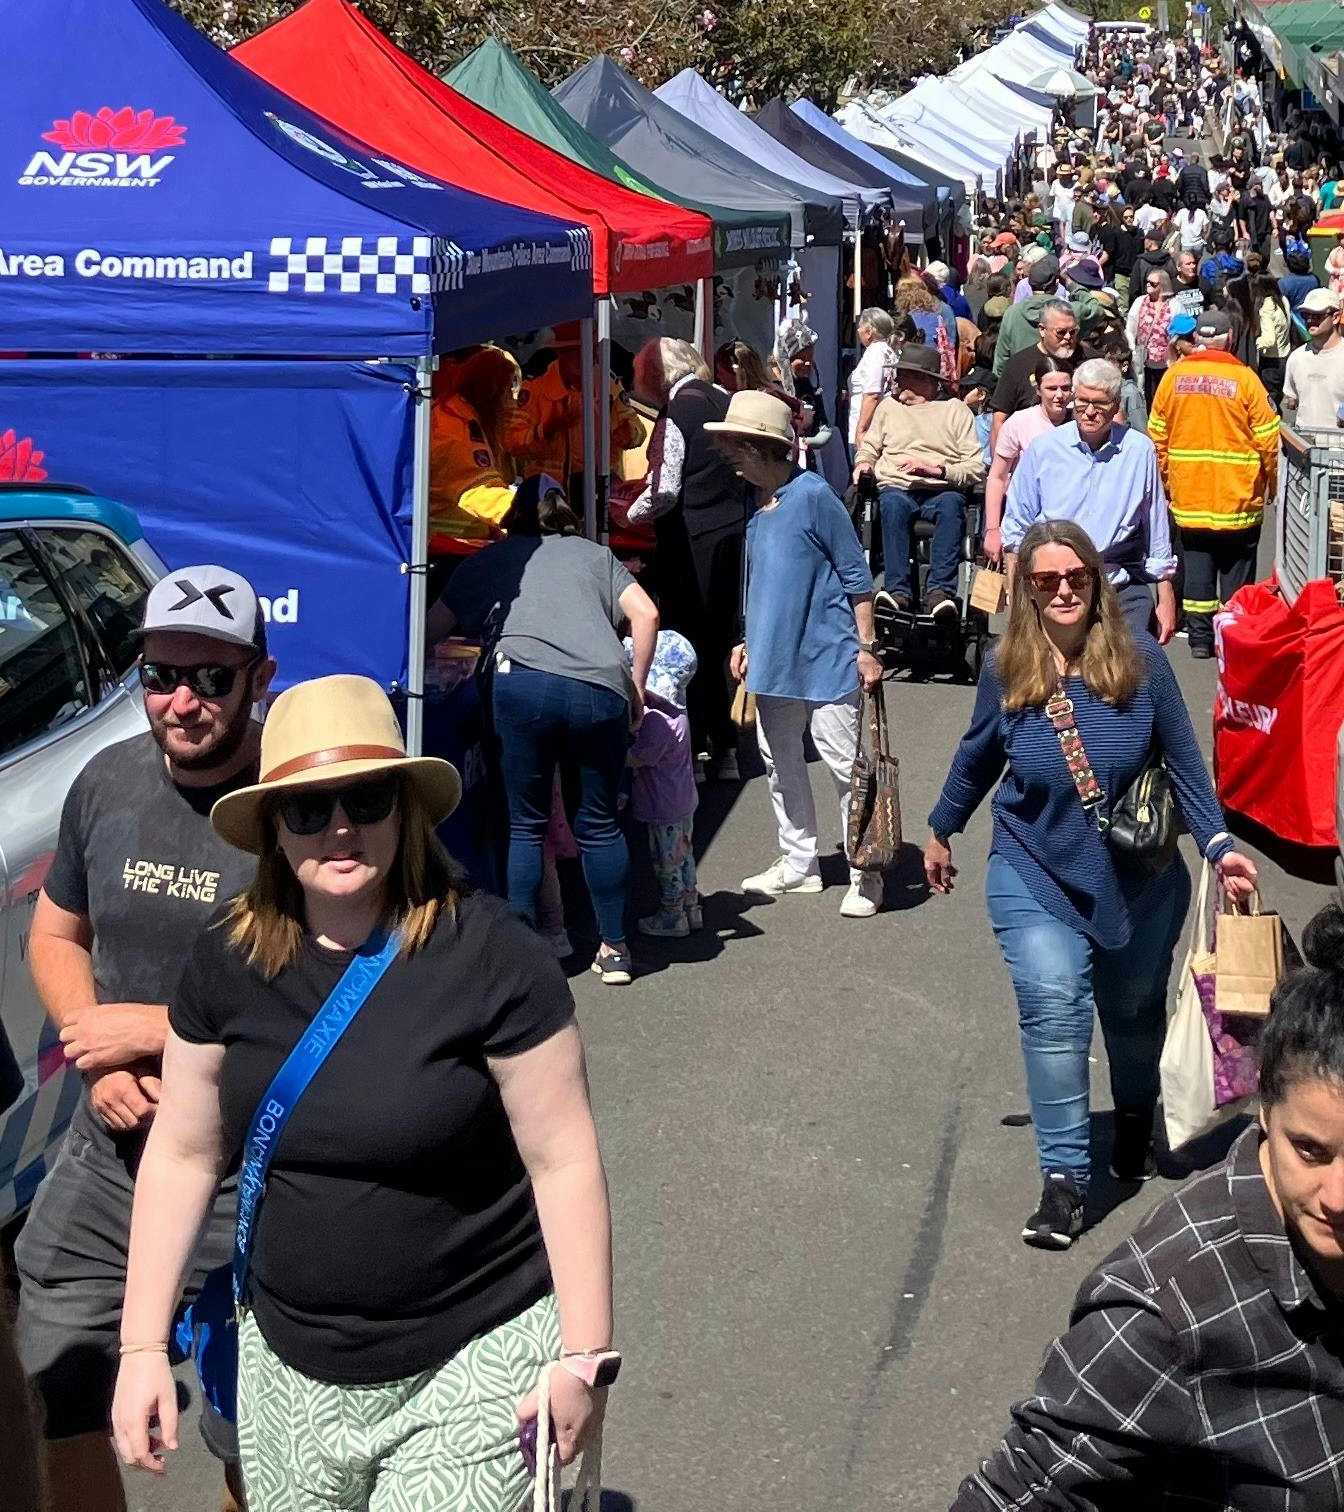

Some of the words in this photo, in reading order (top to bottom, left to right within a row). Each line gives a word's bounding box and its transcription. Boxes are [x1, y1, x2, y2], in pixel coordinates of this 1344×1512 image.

[23, 150, 176, 177] NSW
[17, 175, 162, 188] GOVERNMENT
[74, 249, 253, 279] Command
[123, 857, 175, 881] LONG
[178, 866, 221, 888] LIVE
[122, 873, 161, 894] THE
[166, 880, 216, 903] KING
